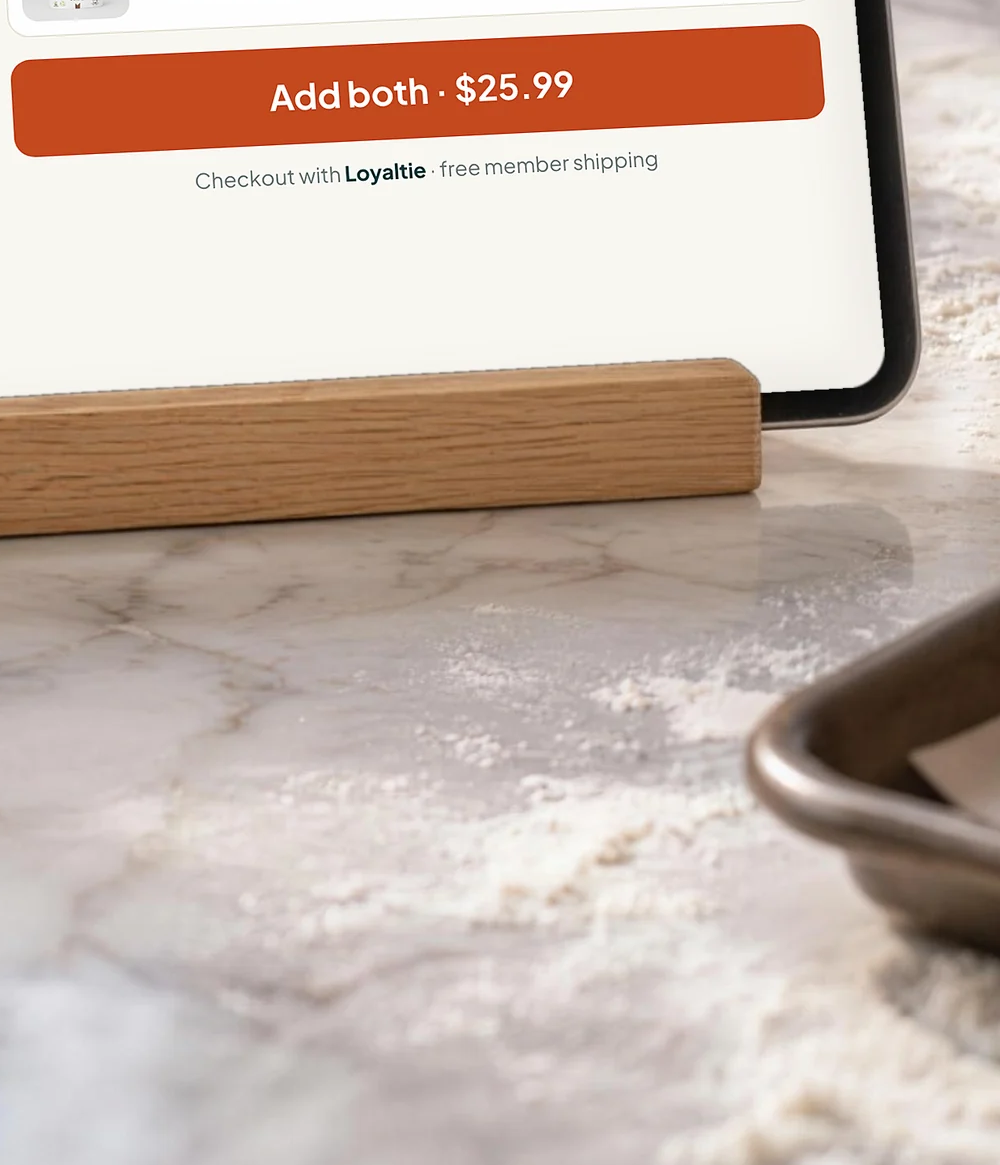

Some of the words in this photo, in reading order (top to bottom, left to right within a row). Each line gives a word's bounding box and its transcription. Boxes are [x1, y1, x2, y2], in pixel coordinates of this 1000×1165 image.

[269, 81, 341, 112] Add
[347, 77, 429, 109] both
[455, 70, 574, 107] $25.99
[195, 169, 296, 190] Checkout
[298, 165, 341, 185] with
[344, 162, 427, 186] Loyaltie
[439, 160, 480, 178] free
[484, 155, 570, 176] member
[573, 151, 658, 174] shipping
